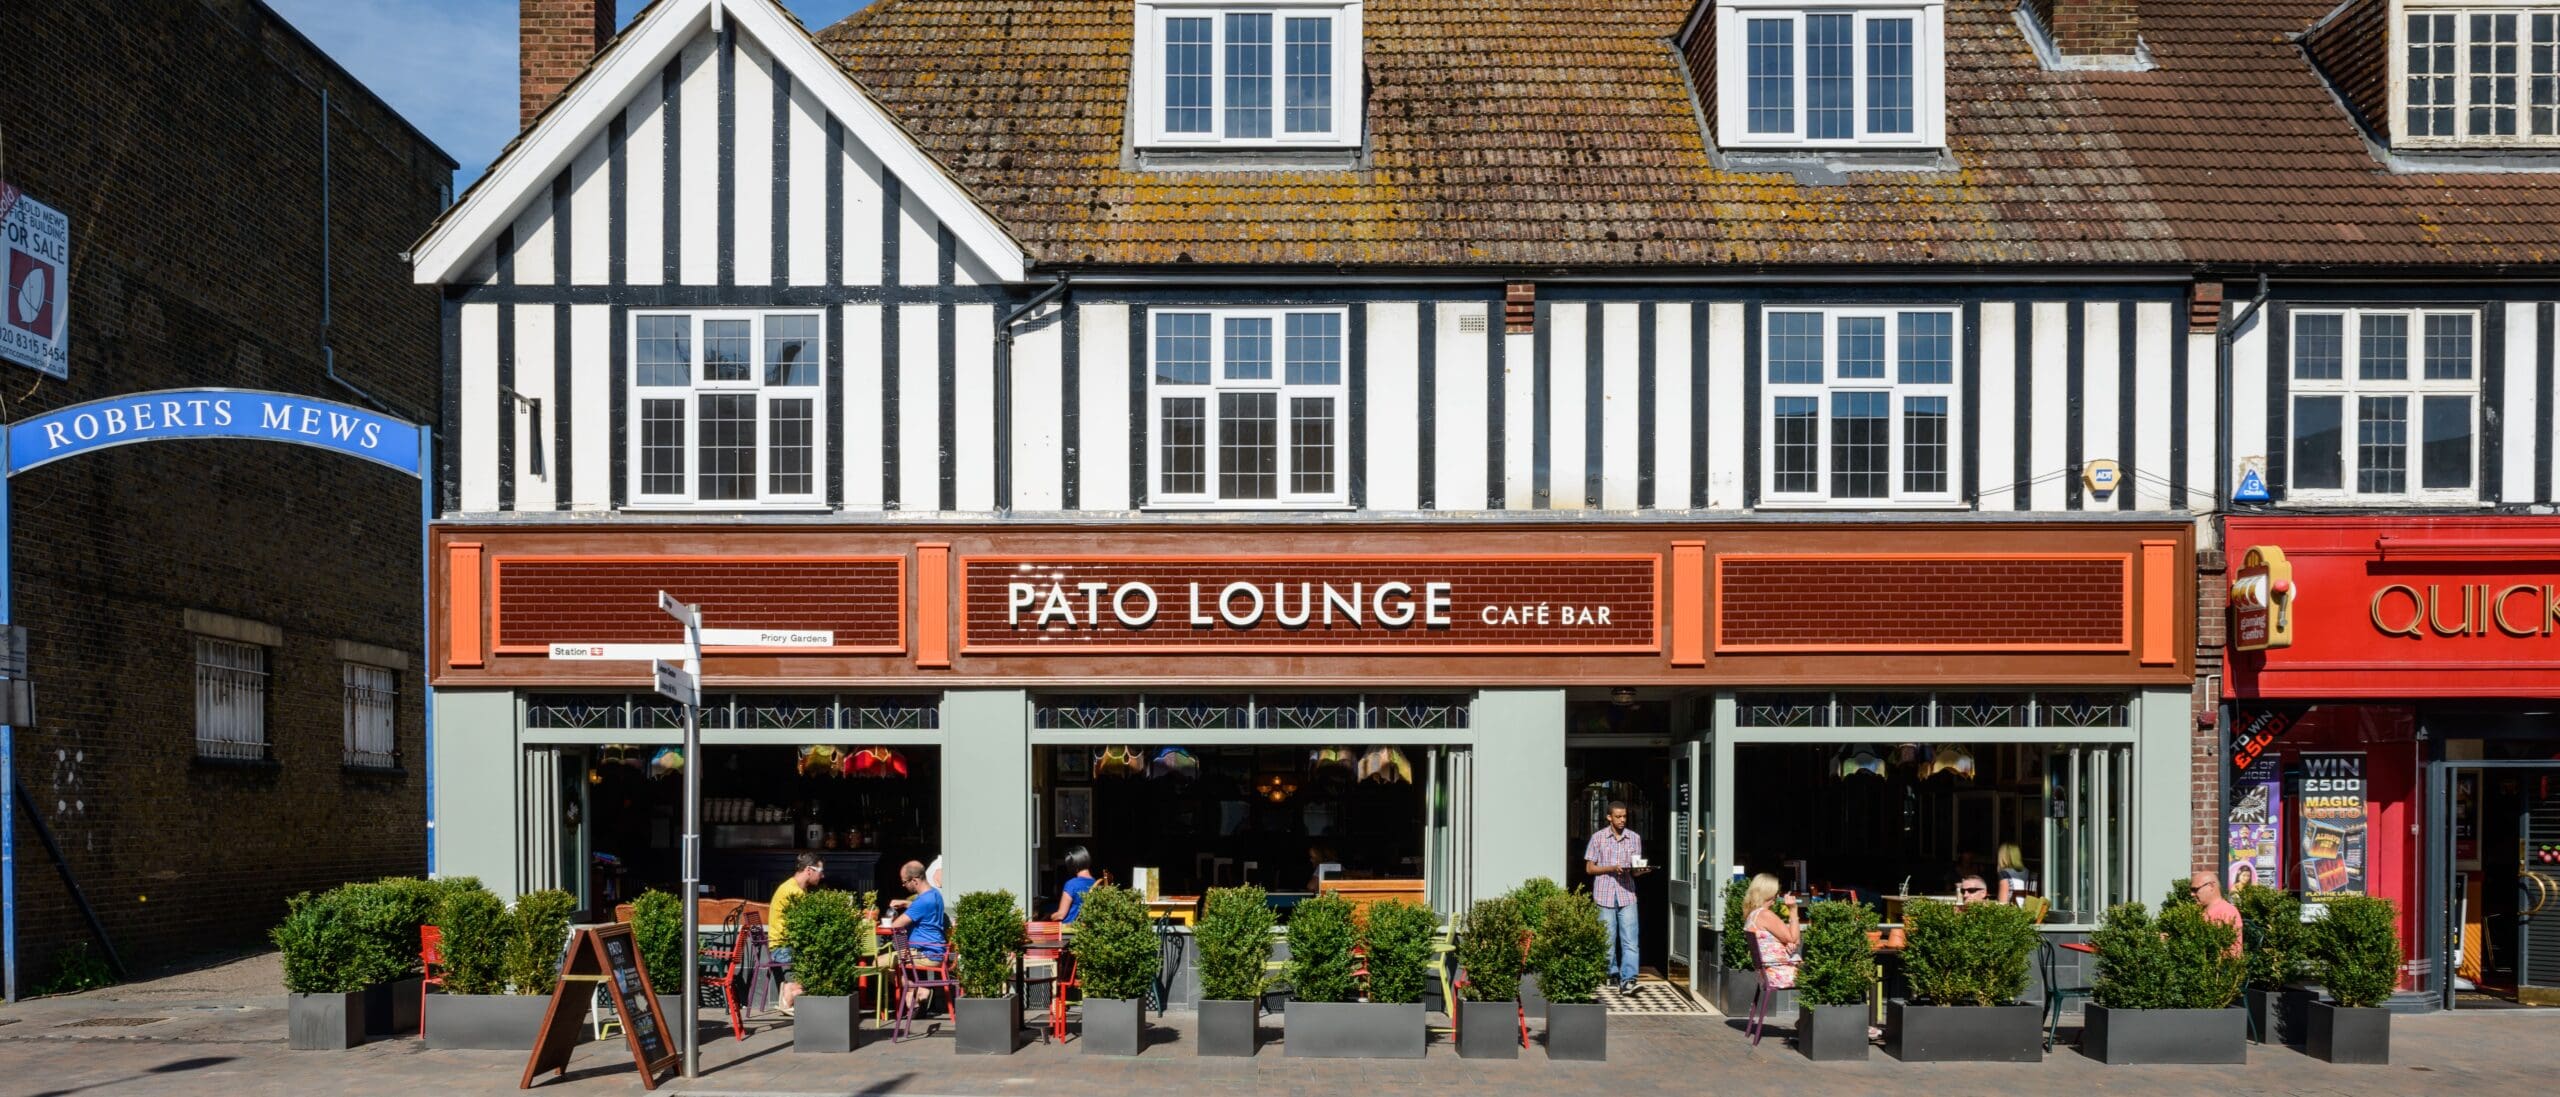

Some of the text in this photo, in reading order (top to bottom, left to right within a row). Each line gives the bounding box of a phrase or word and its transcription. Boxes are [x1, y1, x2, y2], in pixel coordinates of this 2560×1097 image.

[30, 216, 66, 243] BUILDING
[43, 210, 65, 230] MEWS
[33, 233, 65, 265] SALE
[16, 333, 40, 354] 8315
[42, 343, 66, 364] 5454
[43, 400, 381, 450] ROBERTS MEWS
[2096, 470, 2112, 480] ADT
[1008, 581, 1452, 627] PATO LOUNGE
[1481, 601, 1612, 625] CAFÉ BAR
[2371, 584, 2560, 636] QUICK
[2240, 614, 2267, 630] gaming
[761, 634, 828, 645] Priory Gardens
[2241, 628, 2265, 641] centre
[555, 647, 587, 656] Station
[2230, 710, 2273, 752] TO WIN
[2234, 712, 2289, 770] £500!
[2305, 758, 2360, 777] WIN
[2305, 779, 2361, 791] £500
[2305, 796, 2360, 807] MAGIC
